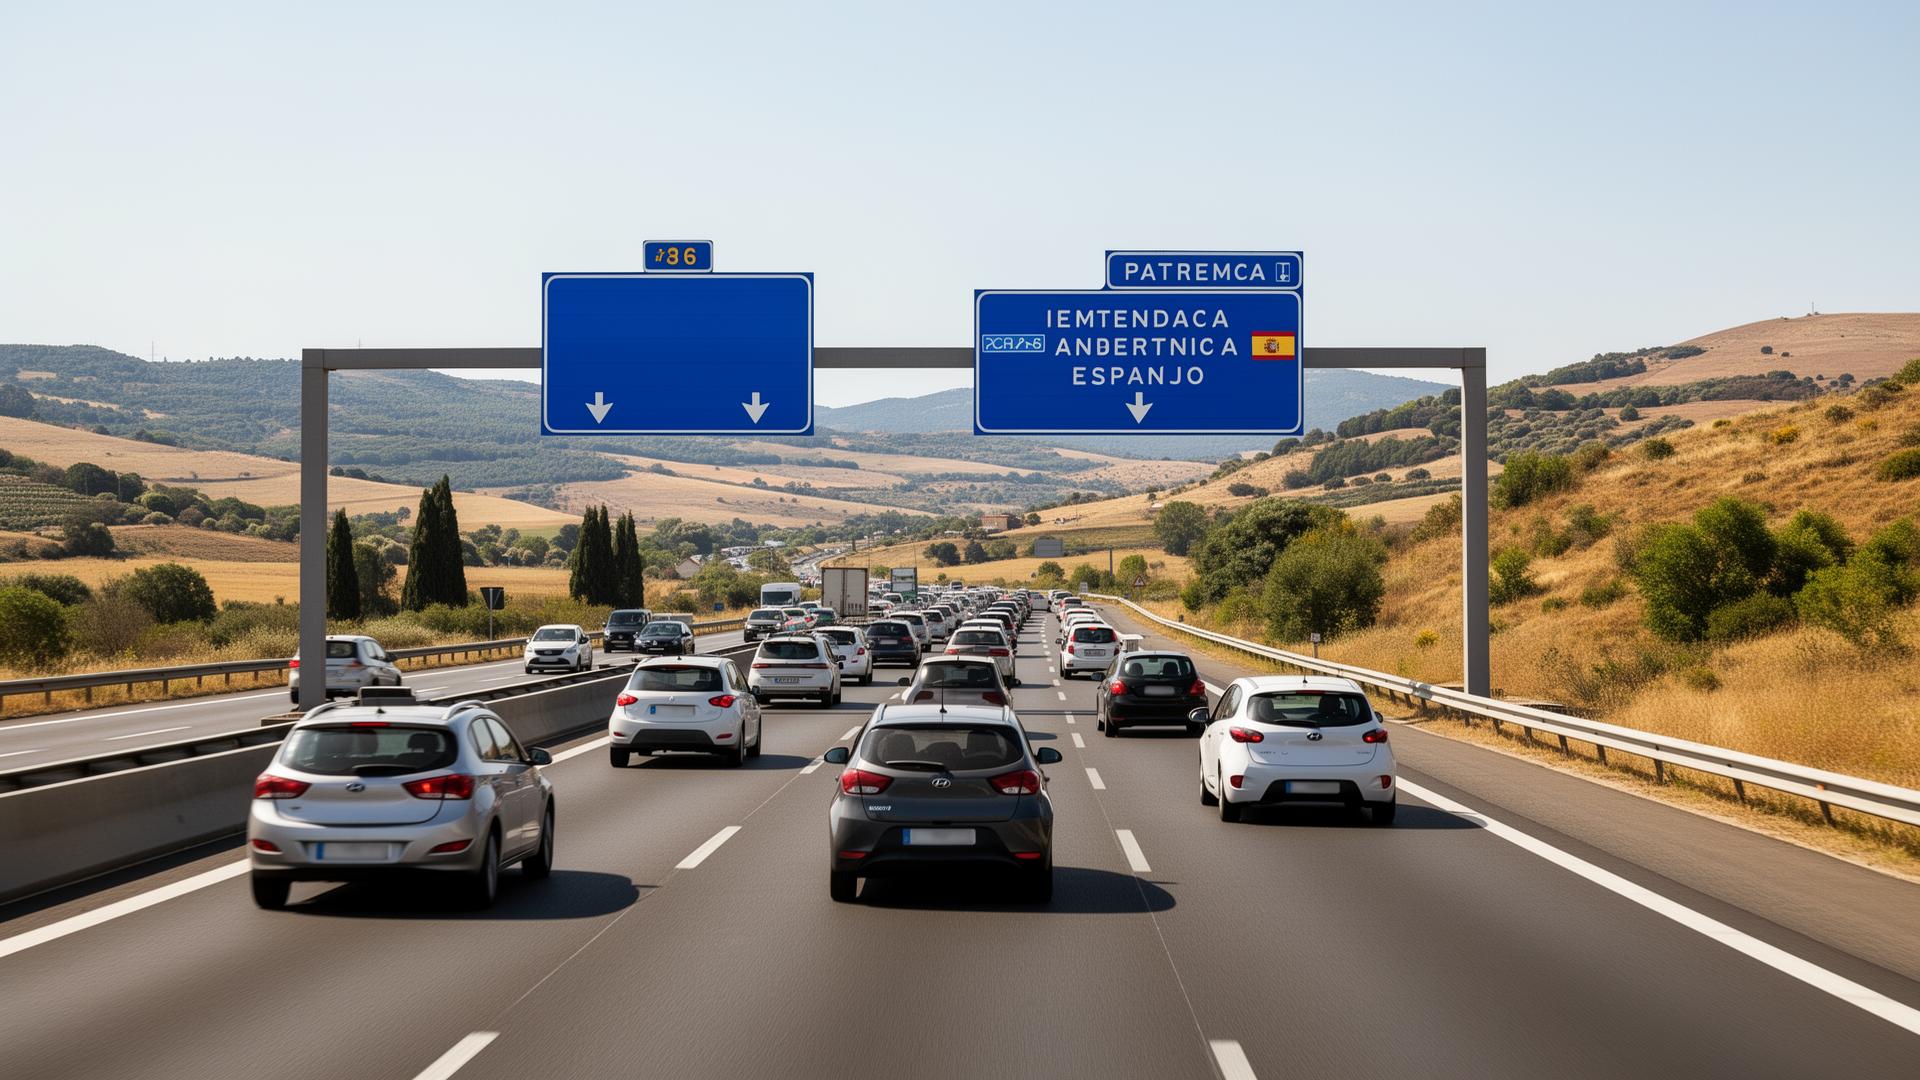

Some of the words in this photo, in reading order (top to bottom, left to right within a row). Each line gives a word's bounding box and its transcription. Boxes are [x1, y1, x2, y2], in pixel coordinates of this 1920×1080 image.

[1125, 262, 1266, 281] PATREMCA
[1047, 309, 1229, 329] IEMTENDACA
[1072, 365, 1204, 386] ESPANJO
